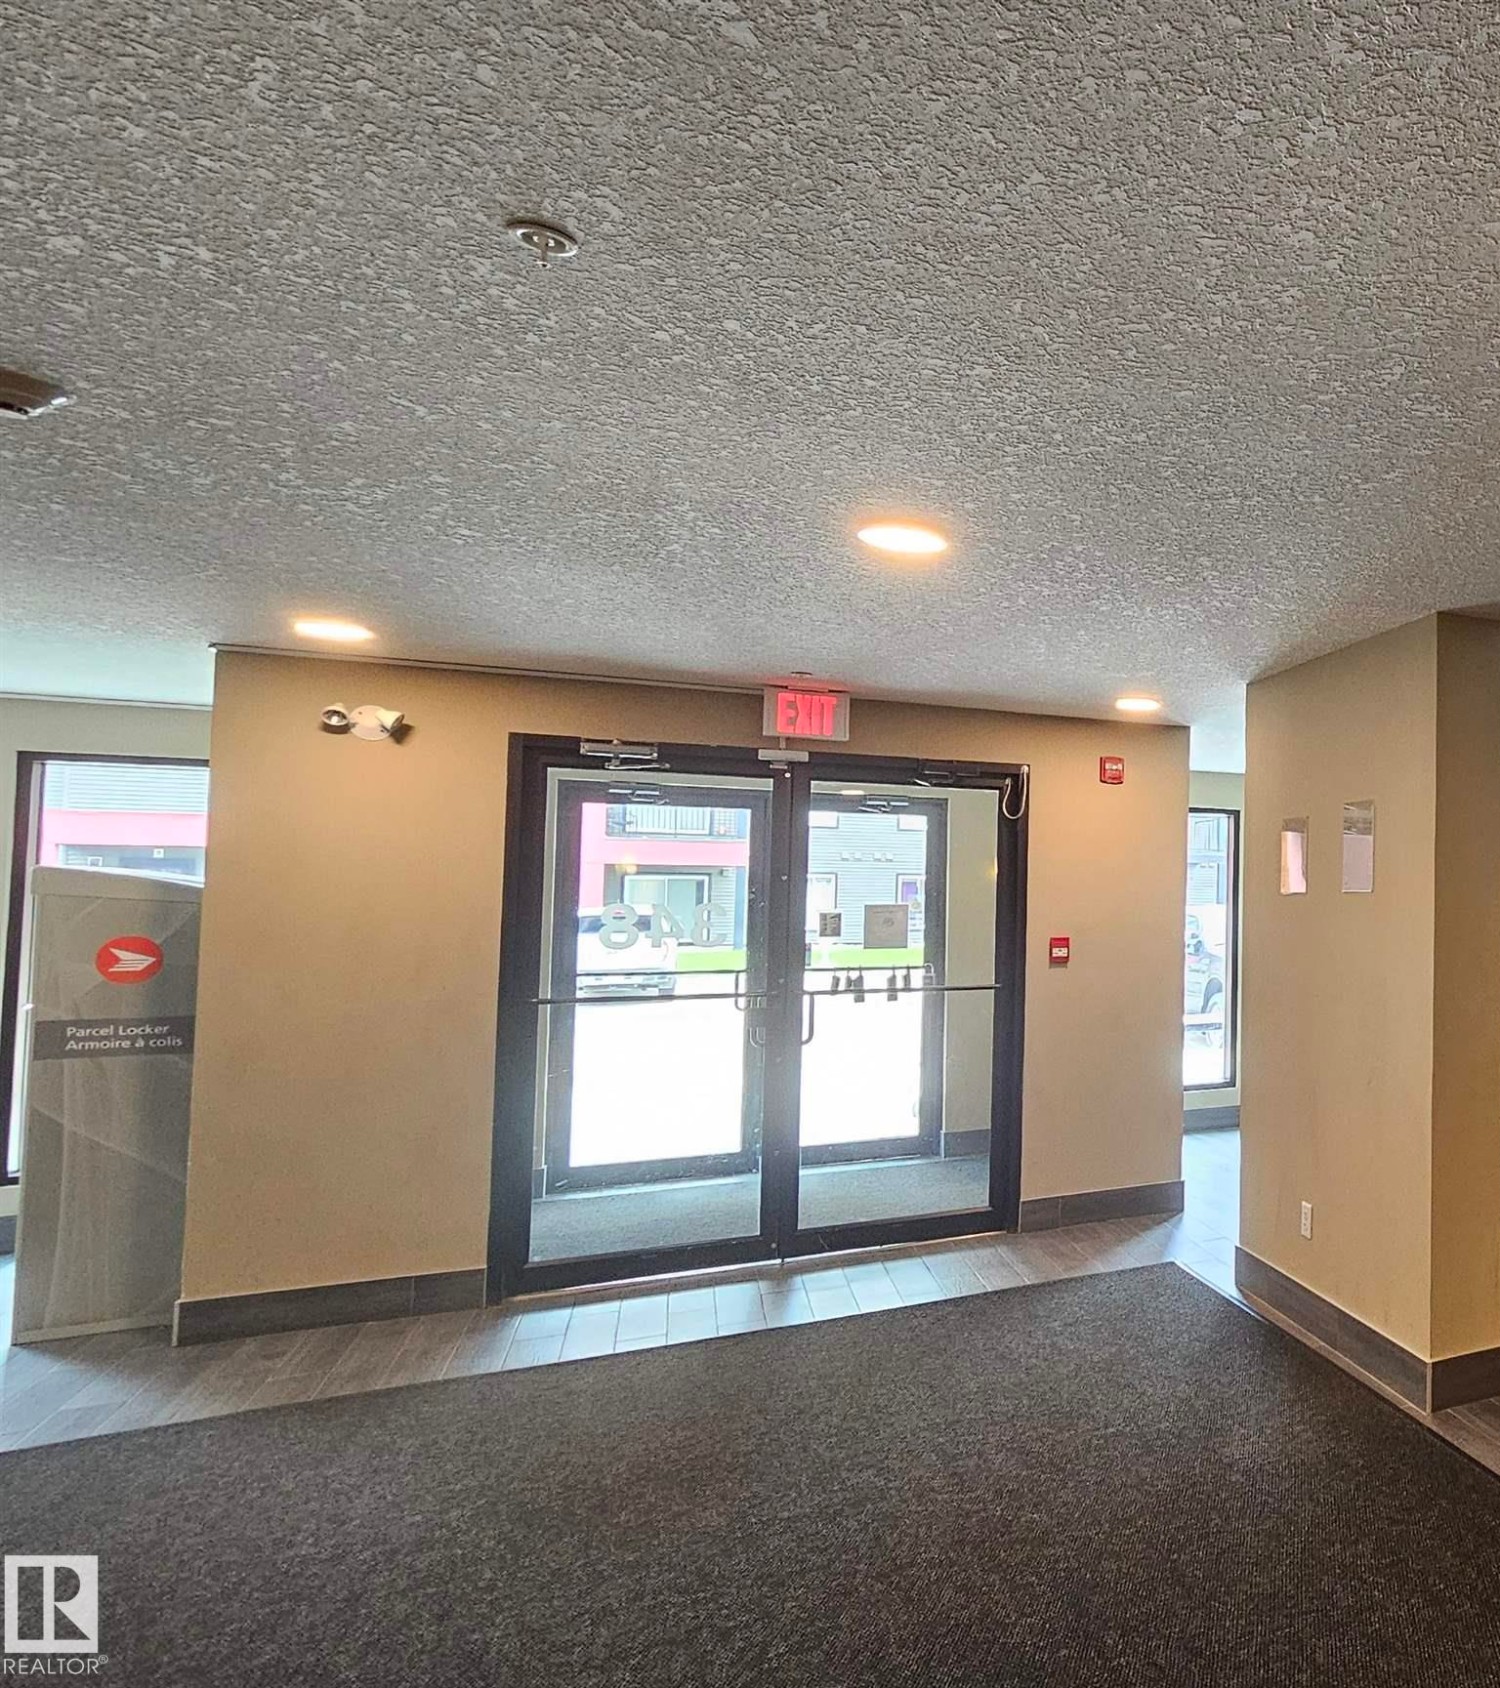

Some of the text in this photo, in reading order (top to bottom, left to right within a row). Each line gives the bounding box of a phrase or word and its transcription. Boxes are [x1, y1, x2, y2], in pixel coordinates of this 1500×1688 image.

[777, 692, 837, 736] EXIT
[66, 1024, 170, 1037] Parcel Locker
[65, 1038, 132, 1050] Armoire
[149, 1036, 183, 1047] colis
